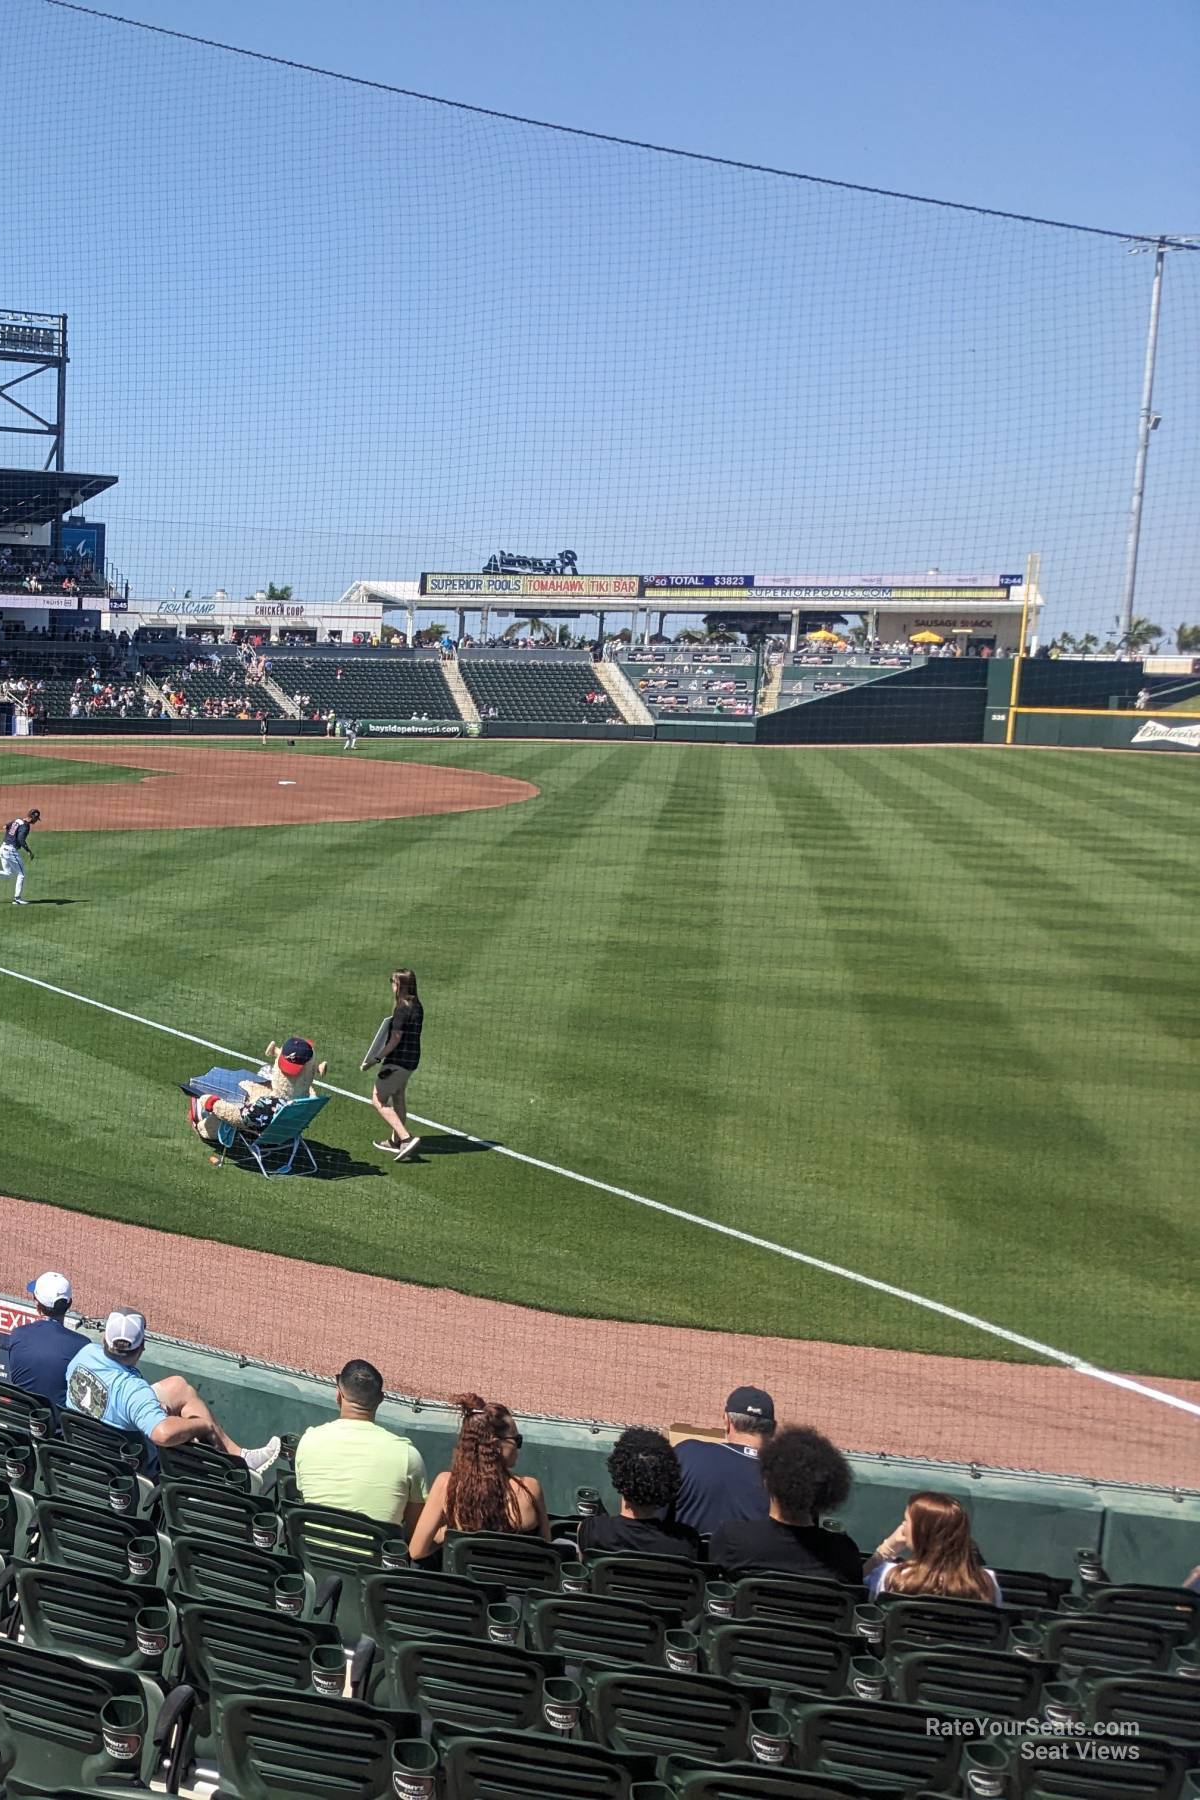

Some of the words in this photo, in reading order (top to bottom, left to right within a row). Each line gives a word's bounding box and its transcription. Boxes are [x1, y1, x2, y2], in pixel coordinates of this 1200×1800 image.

[430, 579, 482, 590] SUPERIOR
[488, 580, 520, 590] POOLS
[527, 580, 584, 592] TOMAHAWK
[590, 580, 608, 592] TIKI
[613, 580, 636, 592] BAR
[669, 577, 704, 585] TOTAL:
[714, 576, 744, 586] $3823
[747, 588, 893, 598] SUPERIORPOOLS.COM
[158, 602, 182, 614] FISH
[185, 602, 216, 614] CAMP
[255, 605, 284, 616] CHICKEN
[286, 605, 304, 616] COOP
[914, 619, 957, 628] SAUSAGE
[1138, 725, 1200, 738] Budweise
[76, 1366, 94, 1382] LOCAL
